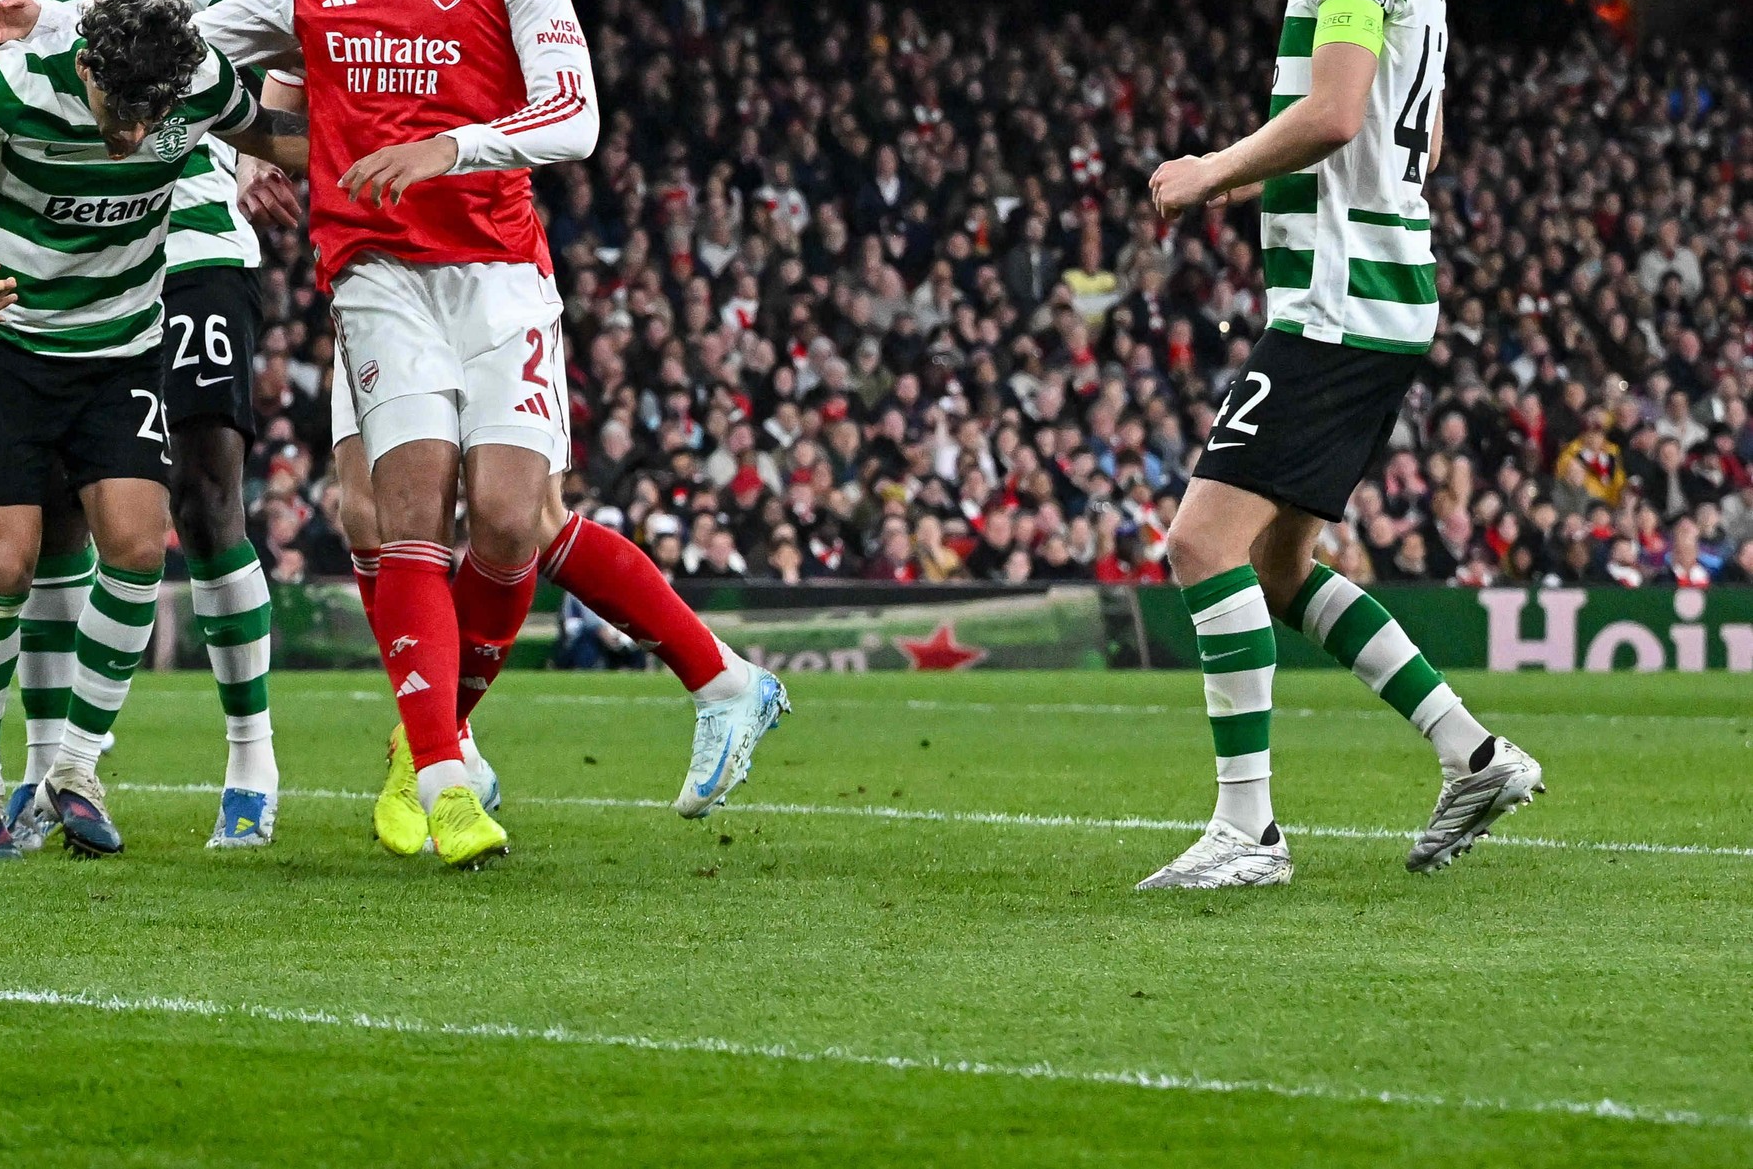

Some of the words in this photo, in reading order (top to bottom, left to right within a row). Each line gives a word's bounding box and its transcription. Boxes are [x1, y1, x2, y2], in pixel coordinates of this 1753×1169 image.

[325, 30, 461, 65] Emirates
[347, 68, 371, 93] FLY
[377, 68, 438, 95] BETTER
[168, 314, 233, 370] 26
[522, 327, 549, 389] 2
